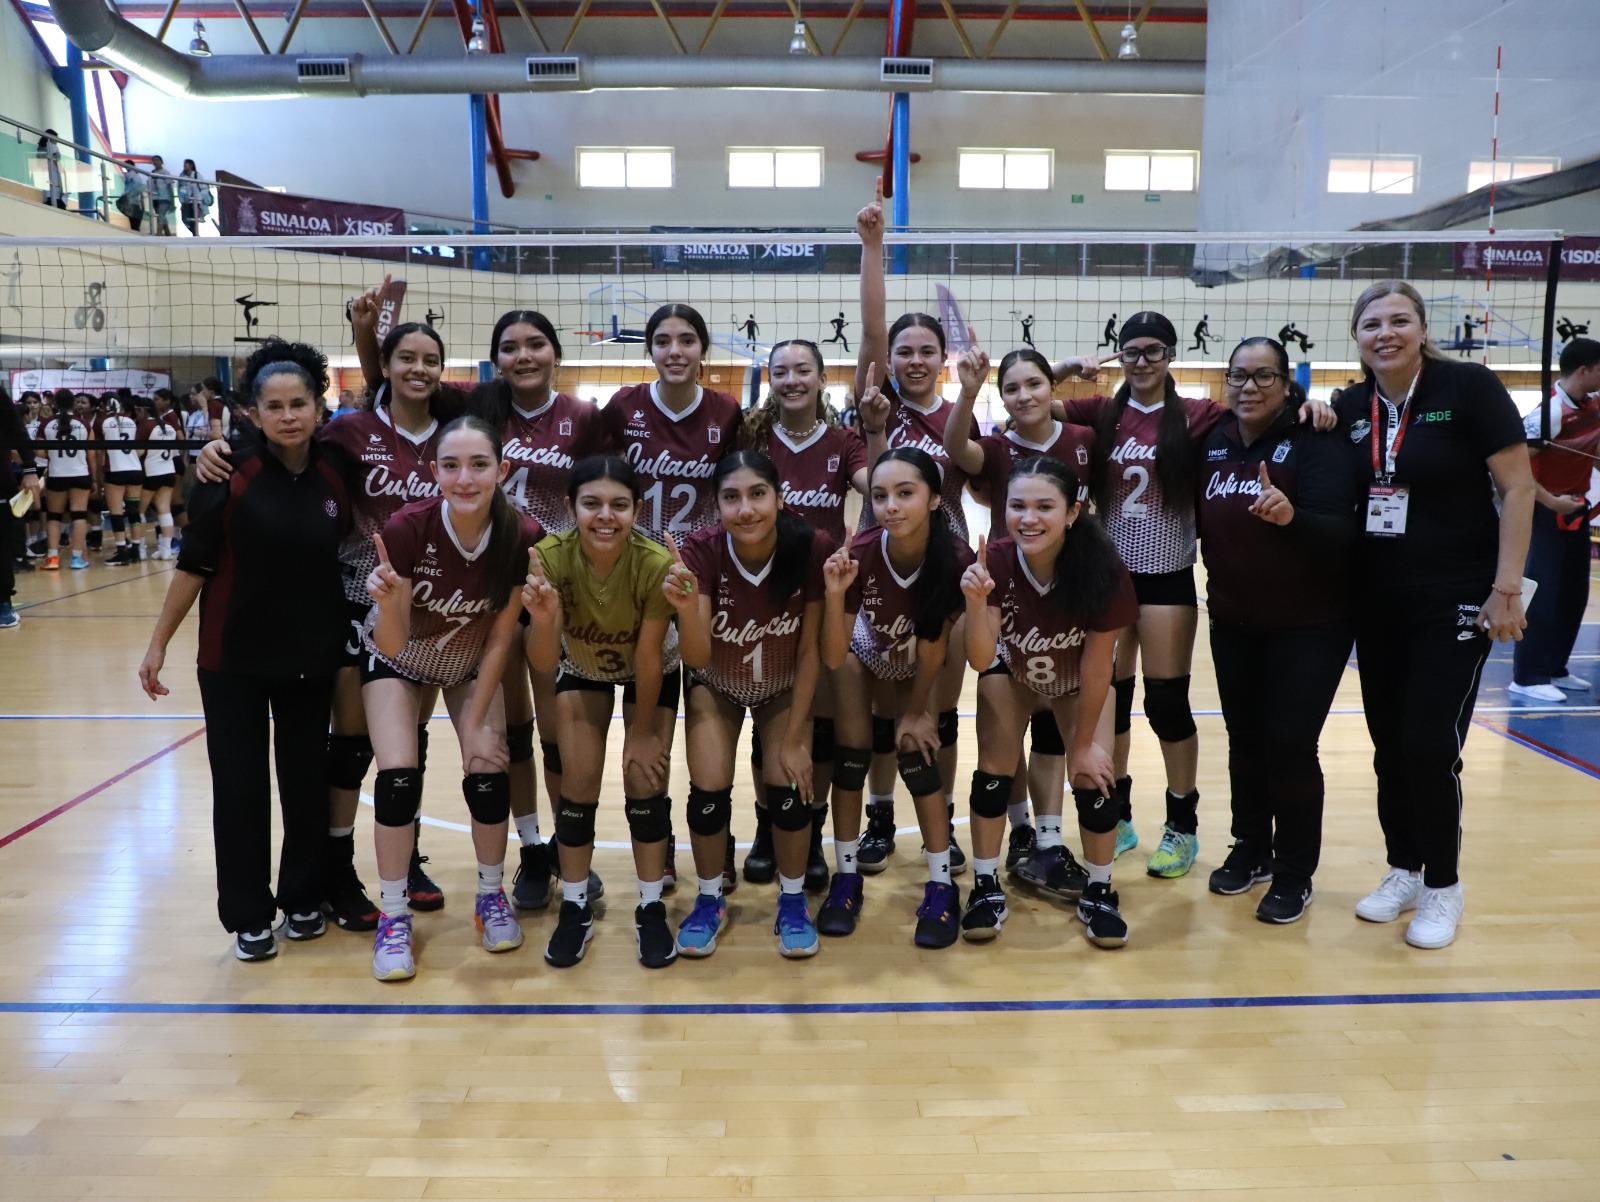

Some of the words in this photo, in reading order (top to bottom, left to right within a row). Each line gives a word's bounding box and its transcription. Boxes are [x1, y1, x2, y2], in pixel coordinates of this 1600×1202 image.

[260, 210, 331, 232] SINALOA
[683, 243, 749, 255] SINALOA
[1482, 248, 1543, 262] SINALOA
[1425, 410, 1452, 422] ISDE
[624, 429, 651, 438] IMDEC
[361, 453, 394, 461] IMDEC
[502, 437, 574, 470] liacán
[1122, 465, 1150, 519] 2
[643, 480, 697, 532] 12
[413, 566, 443, 577] IMDEC
[434, 616, 472, 653] 7
[595, 648, 626, 674] 3
[742, 639, 763, 683] 1
[1026, 655, 1057, 684] 8
